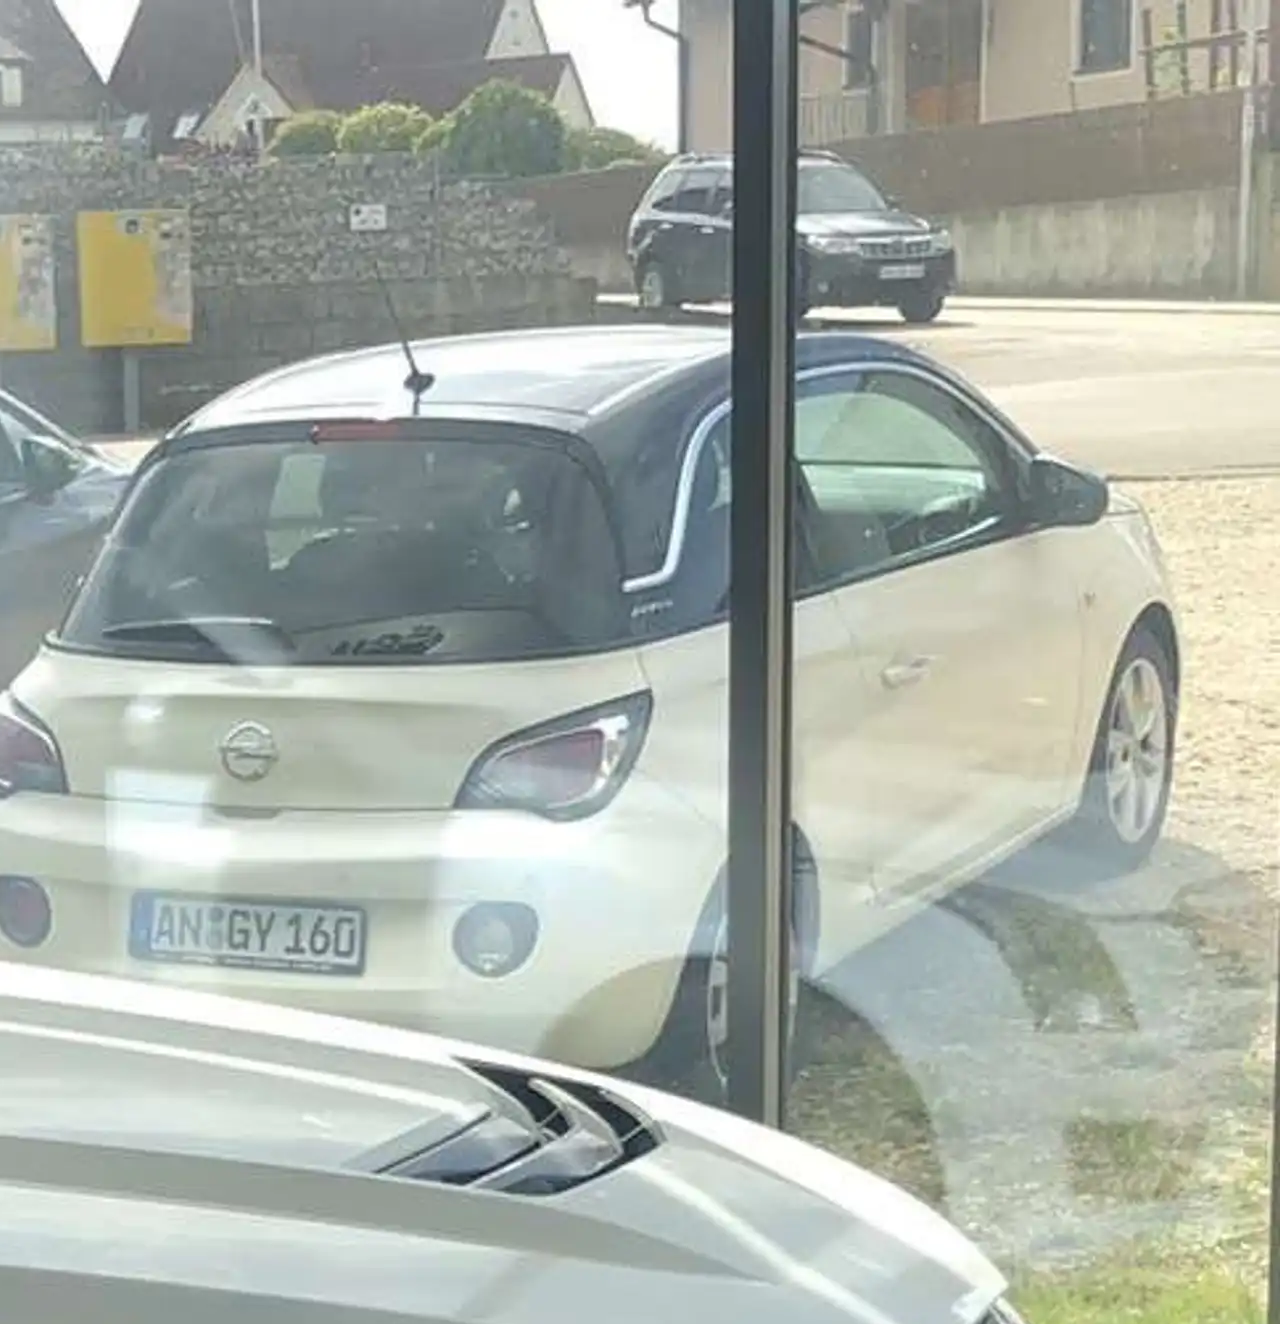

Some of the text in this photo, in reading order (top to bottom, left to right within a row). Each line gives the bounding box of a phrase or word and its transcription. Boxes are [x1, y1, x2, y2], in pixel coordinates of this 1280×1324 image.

[155, 904, 355, 957] AN GY 160
